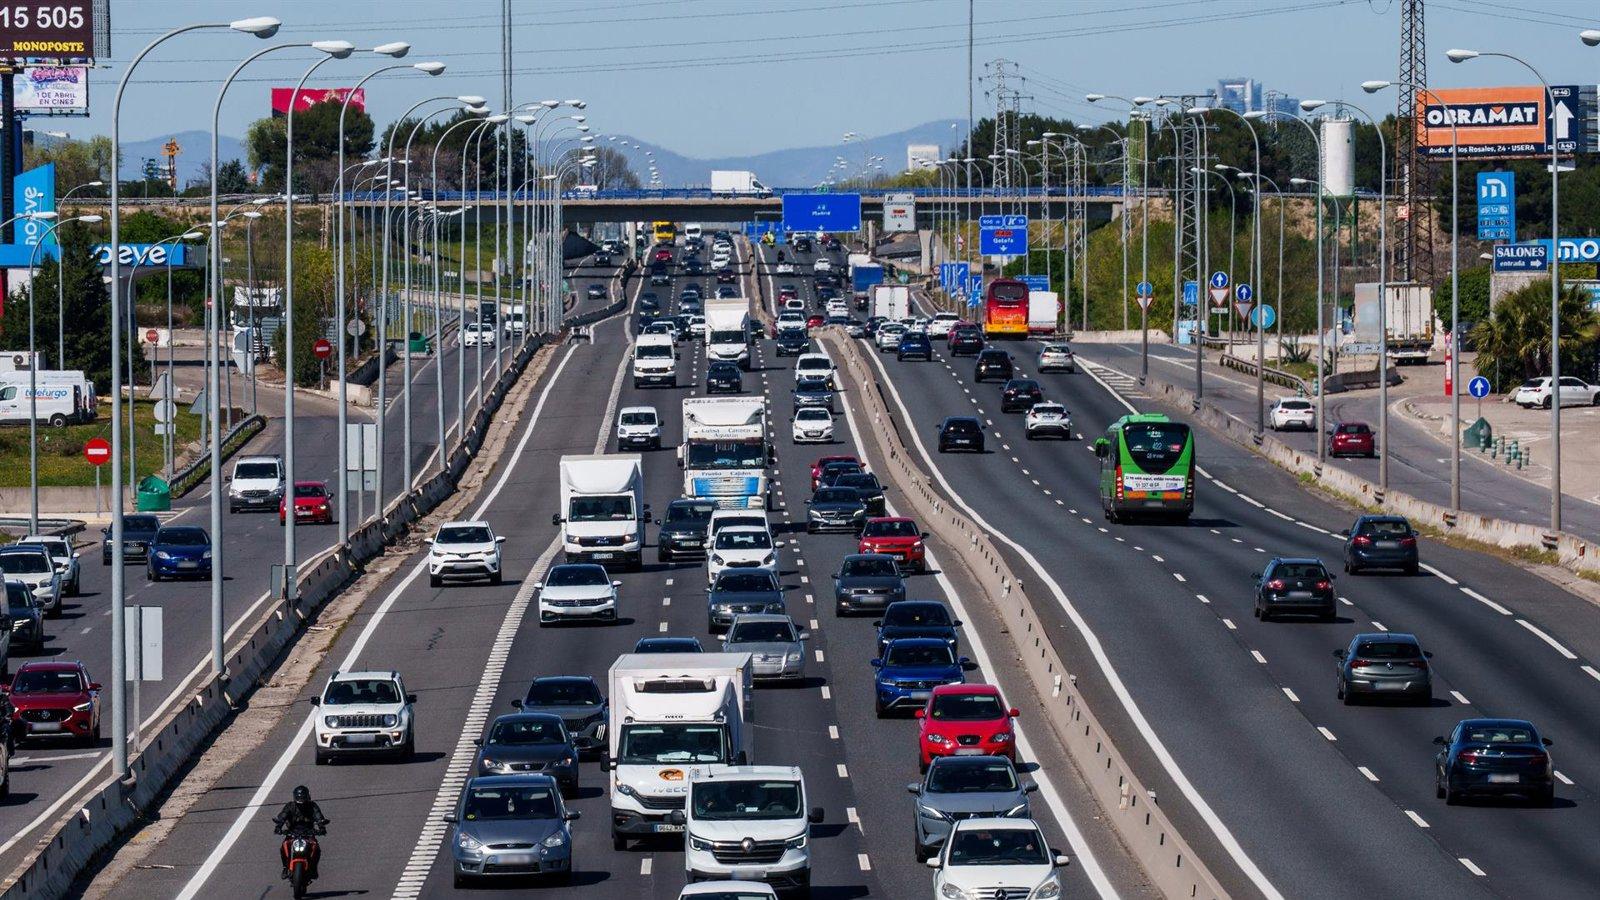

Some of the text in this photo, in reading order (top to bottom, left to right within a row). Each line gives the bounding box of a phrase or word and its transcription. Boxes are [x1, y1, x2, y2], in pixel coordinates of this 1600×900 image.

[0, 6, 84, 28] 15 505
[13, 41, 85, 52] MONOPOSTE
[1427, 107, 1536, 125] OBRAMAT
[1511, 144, 1535, 152] USERA
[92, 245, 166, 264] oeve
[1496, 246, 1545, 258] SALONES
[1499, 260, 1526, 268] entrada
[25, 387, 68, 399] teefurgo
